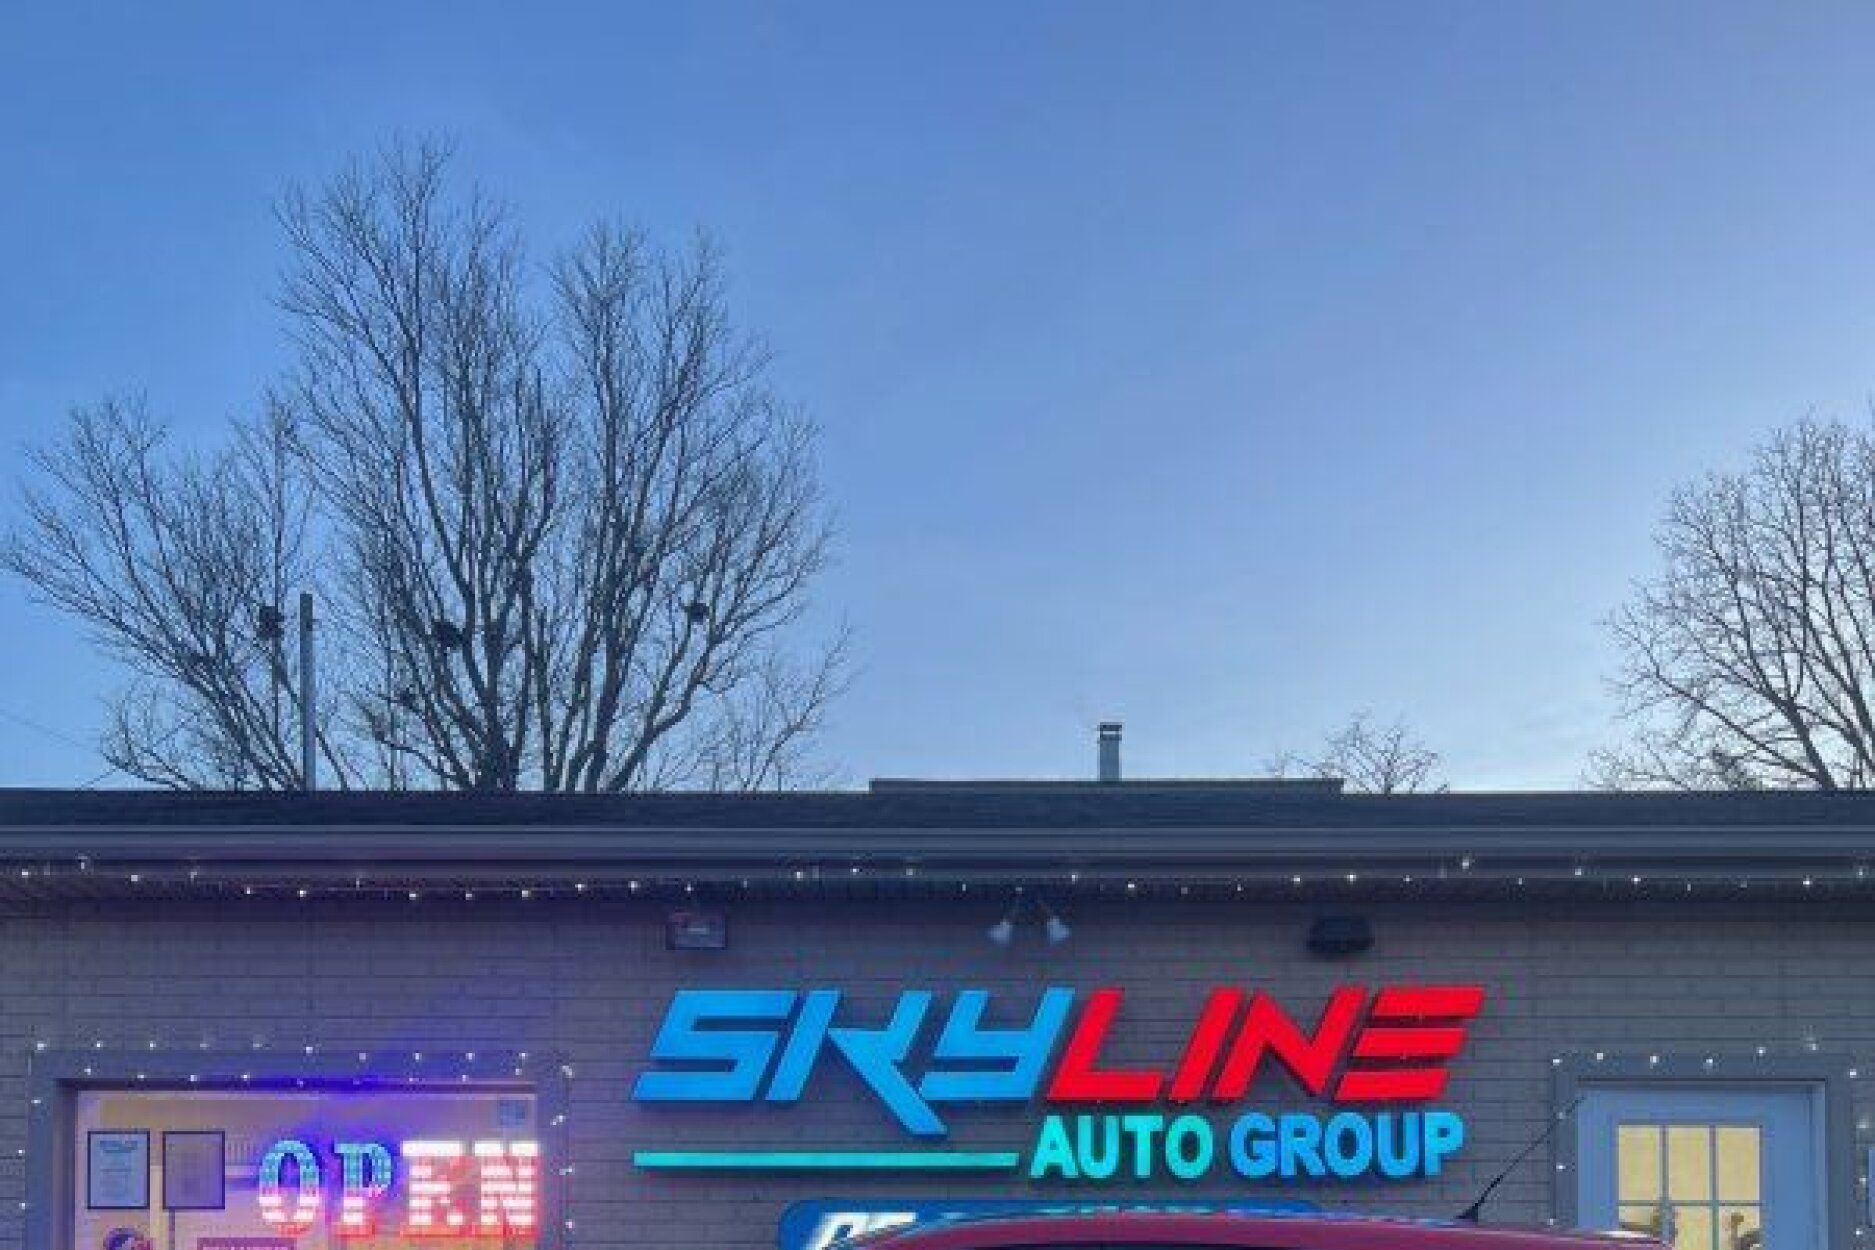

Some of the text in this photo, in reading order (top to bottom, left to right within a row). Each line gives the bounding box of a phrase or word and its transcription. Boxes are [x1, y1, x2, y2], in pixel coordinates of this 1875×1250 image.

[631, 986, 1485, 1136] SKYLINE
[259, 1140, 538, 1237] OPEN
[1030, 1111, 1464, 1179] AUTO GROUP
